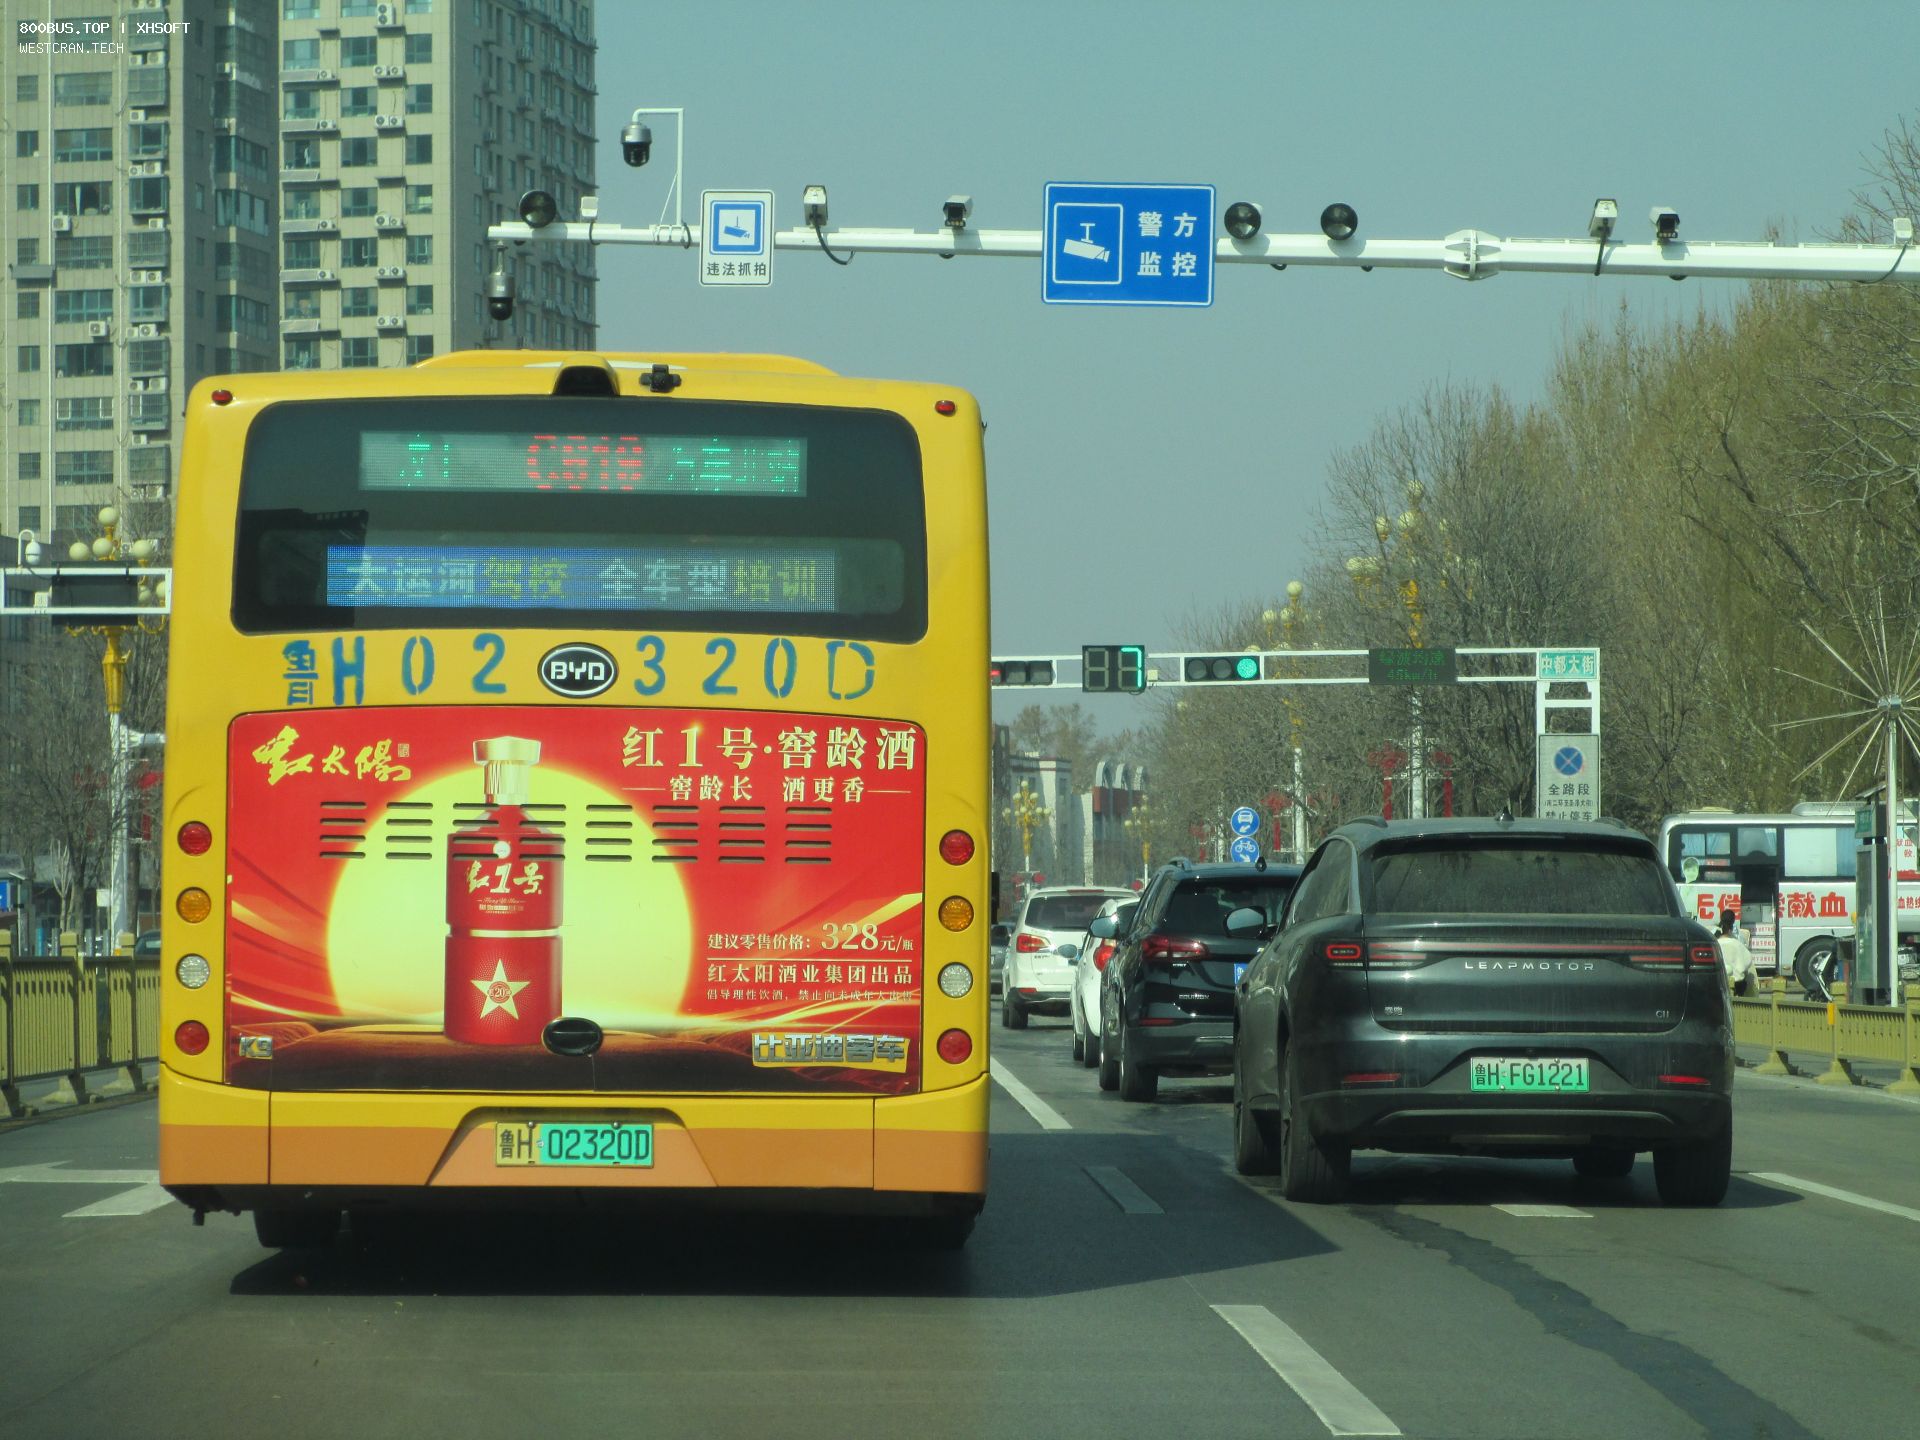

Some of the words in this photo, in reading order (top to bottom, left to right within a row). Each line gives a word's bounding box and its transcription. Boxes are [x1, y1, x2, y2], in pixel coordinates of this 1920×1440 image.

[1138, 211, 1197, 238] 警方
[706, 262, 767, 276] 违法抓拍
[1137, 251, 1197, 277] 监控
[346, 555, 568, 600] 大运河驾校
[599, 558, 816, 602] 全车型培训
[550, 661, 605, 681] BYD
[1541, 654, 1594, 674] 中都大街
[669, 775, 753, 802] 窖龄长
[782, 776, 865, 803] 酒更香
[1549, 783, 1590, 796] 全路段
[707, 963, 913, 984] 红太阳酒业集团出品
[1464, 961, 1595, 971] LEAPMOTOR
[239, 1036, 273, 1058] K9
[753, 1033, 906, 1062] 比亚迪客车
